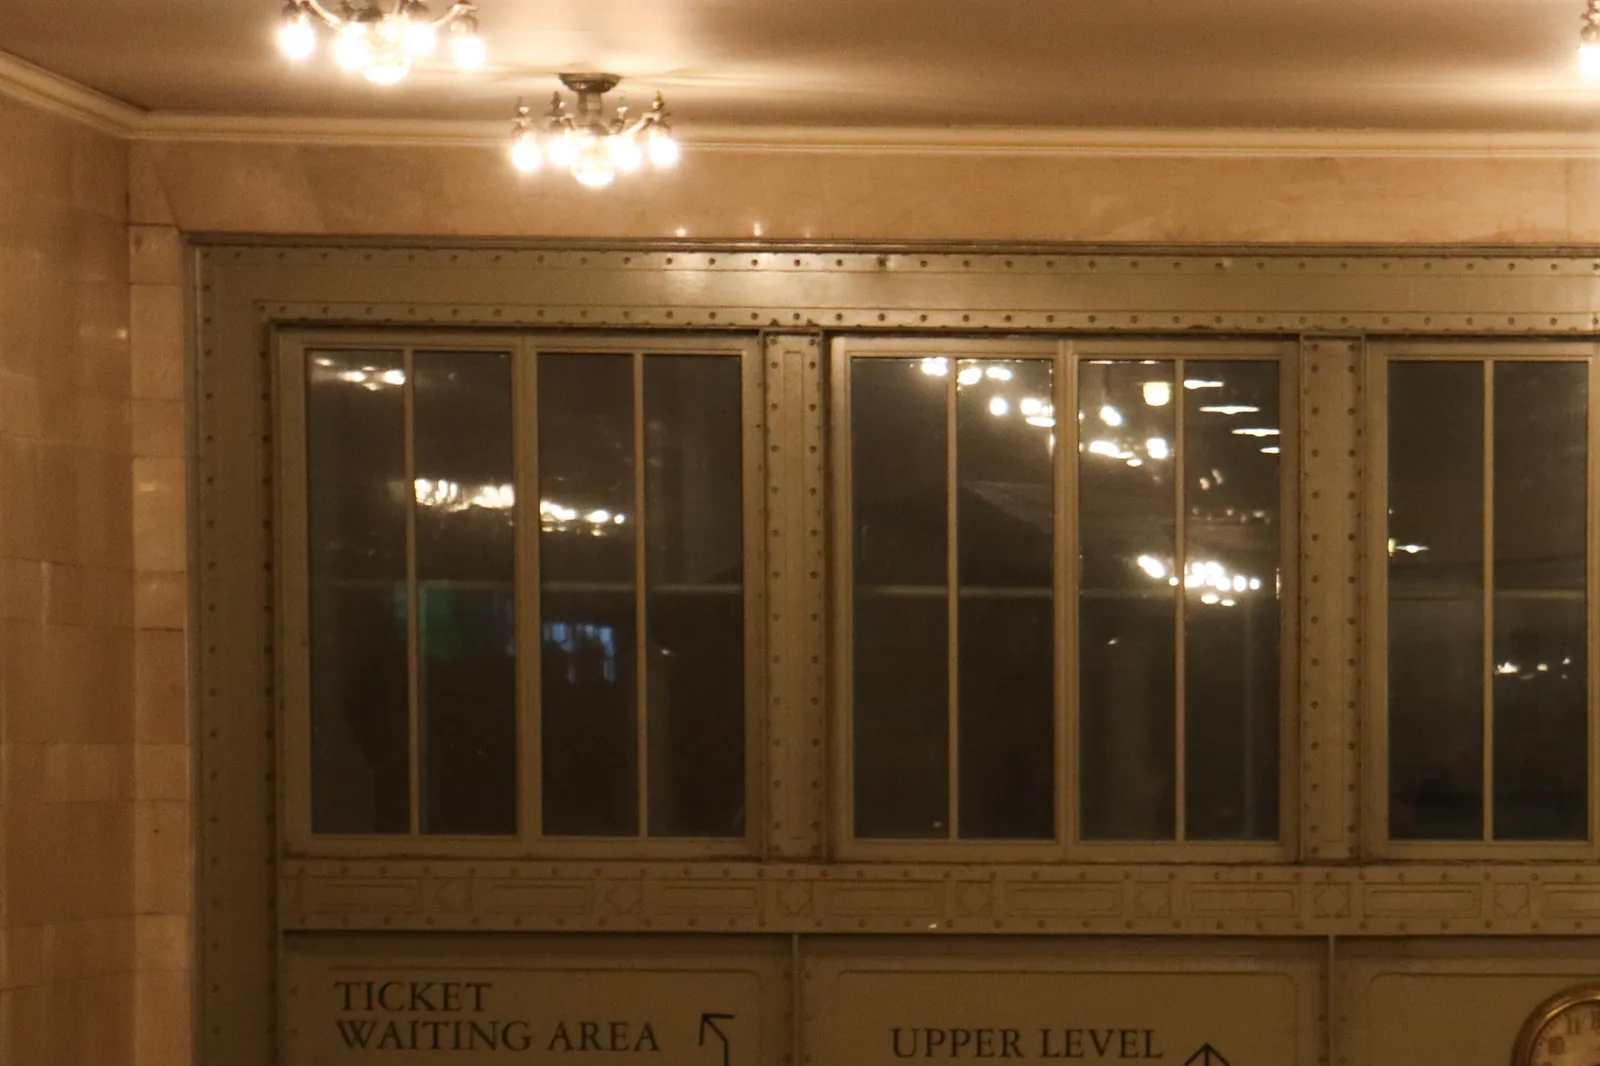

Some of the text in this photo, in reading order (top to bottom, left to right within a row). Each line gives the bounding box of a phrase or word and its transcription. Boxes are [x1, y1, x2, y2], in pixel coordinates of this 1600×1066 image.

[334, 981, 492, 1012] TICKET
[335, 1019, 661, 1052] WAITING AREA
[890, 1027, 1164, 1059] UPPER LEVEL
